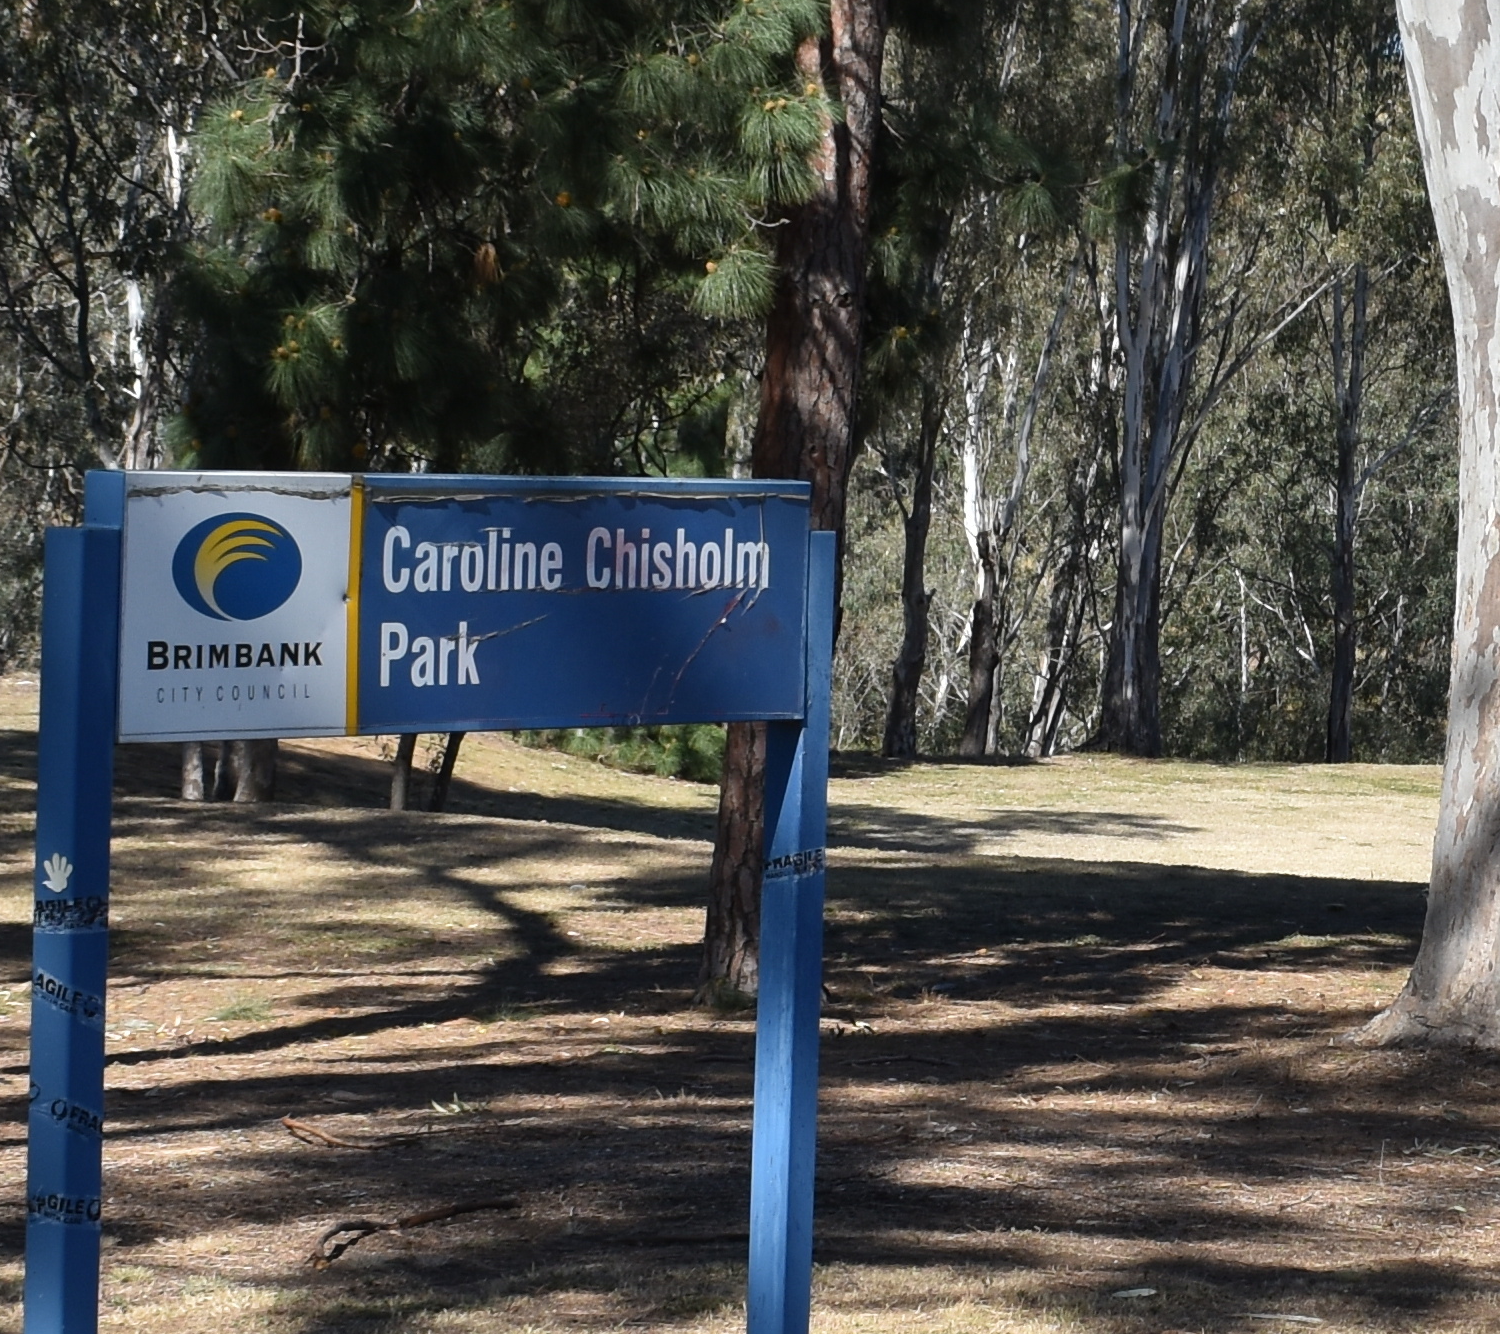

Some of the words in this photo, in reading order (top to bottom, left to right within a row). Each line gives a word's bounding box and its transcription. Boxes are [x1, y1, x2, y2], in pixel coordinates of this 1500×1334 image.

[383, 525, 563, 593] Caroline
[586, 526, 770, 590] Chisholm
[147, 641, 323, 670] BRIMBANK
[380, 621, 480, 688] Park
[156, 686, 203, 704] CITY
[216, 683, 311, 702] COUNCIL
